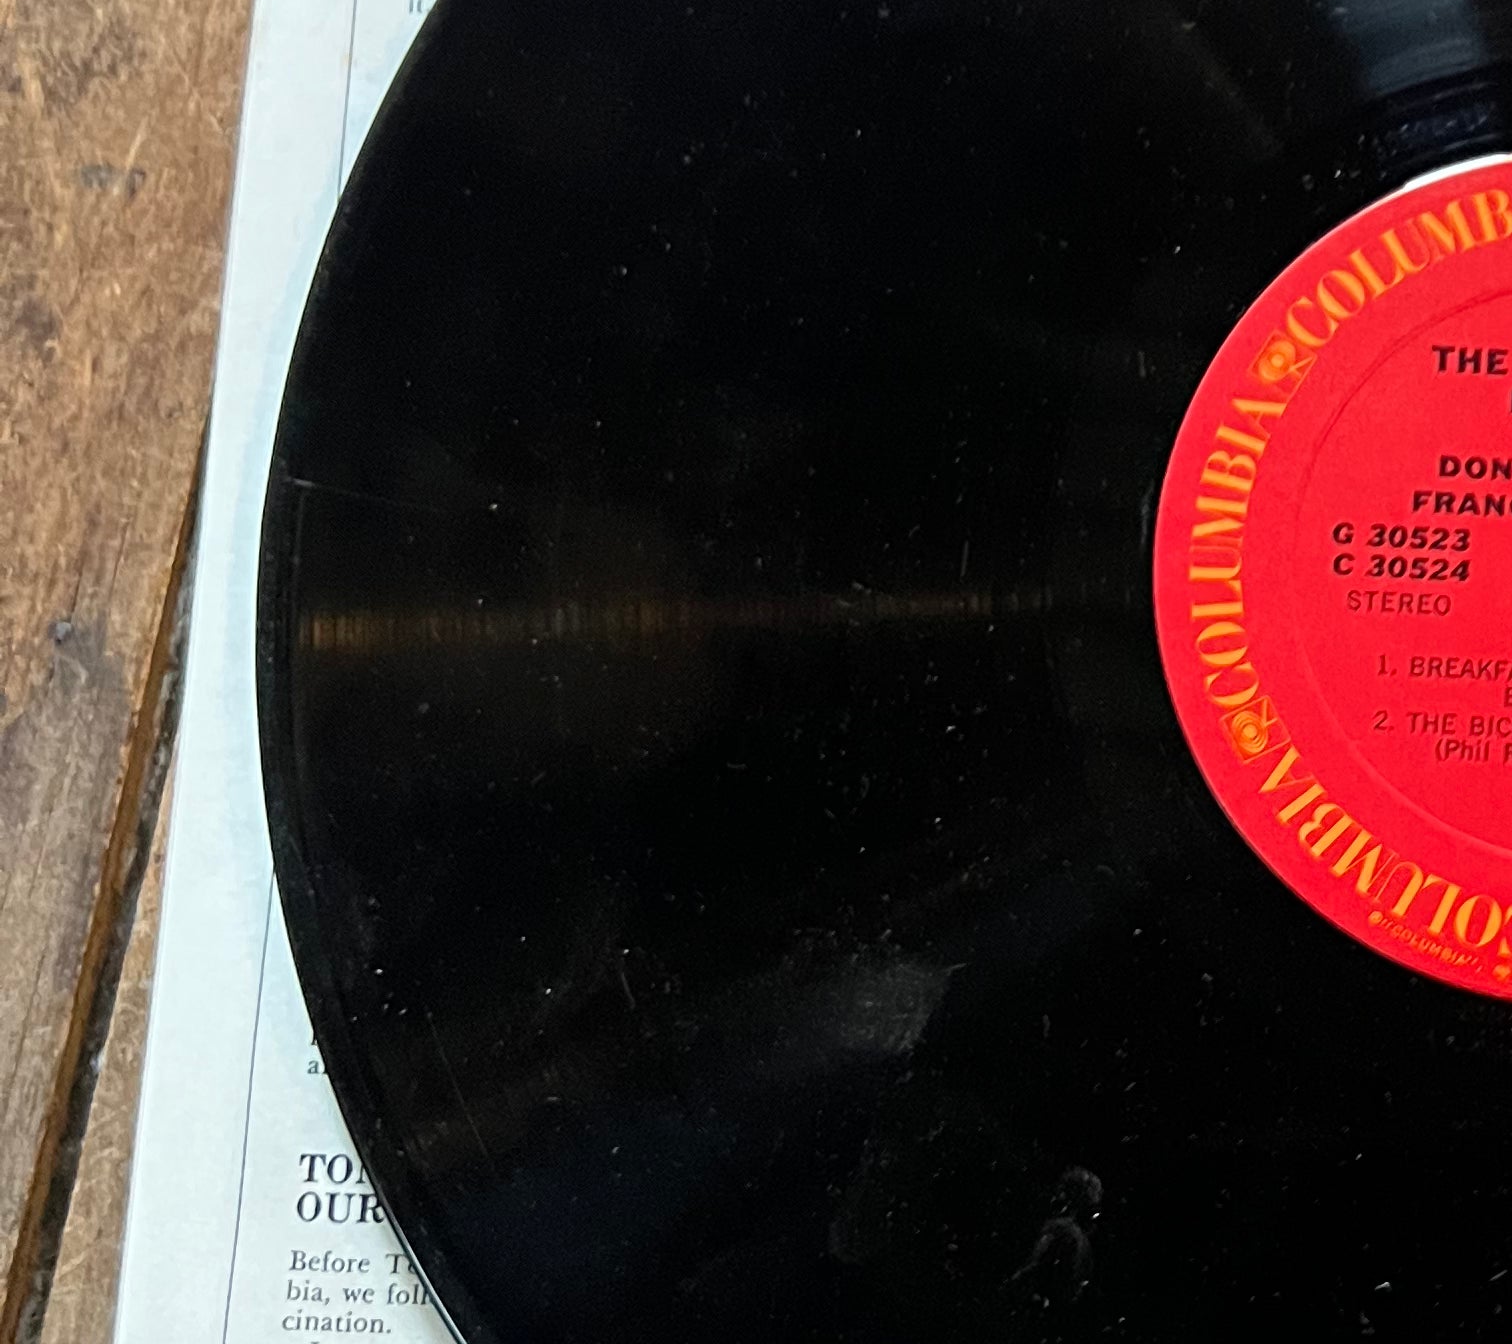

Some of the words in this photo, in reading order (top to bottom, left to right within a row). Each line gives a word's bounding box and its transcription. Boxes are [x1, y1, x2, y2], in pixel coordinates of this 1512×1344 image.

[1432, 346, 1507, 375] THE
[1439, 455, 1512, 480] DON
[1333, 523, 1353, 544] G
[1367, 524, 1470, 551] 30523
[1188, 396, 1285, 706] COLUMBIA
[1333, 554, 1354, 575] C
[1367, 555, 1469, 581] 30524
[1347, 590, 1451, 616] STEREO
[1378, 655, 1396, 675] 1.
[1374, 710, 1393, 730] 2.
[1407, 712, 1457, 735] THE
[1435, 740, 1489, 764] (Phil
[300, 1154, 367, 1184] TO
[297, 1191, 384, 1223] OUR
[289, 1250, 370, 1273] Before
[287, 1280, 330, 1305] bia,
[343, 1288, 375, 1304] we
[282, 1310, 391, 1334] cination.
